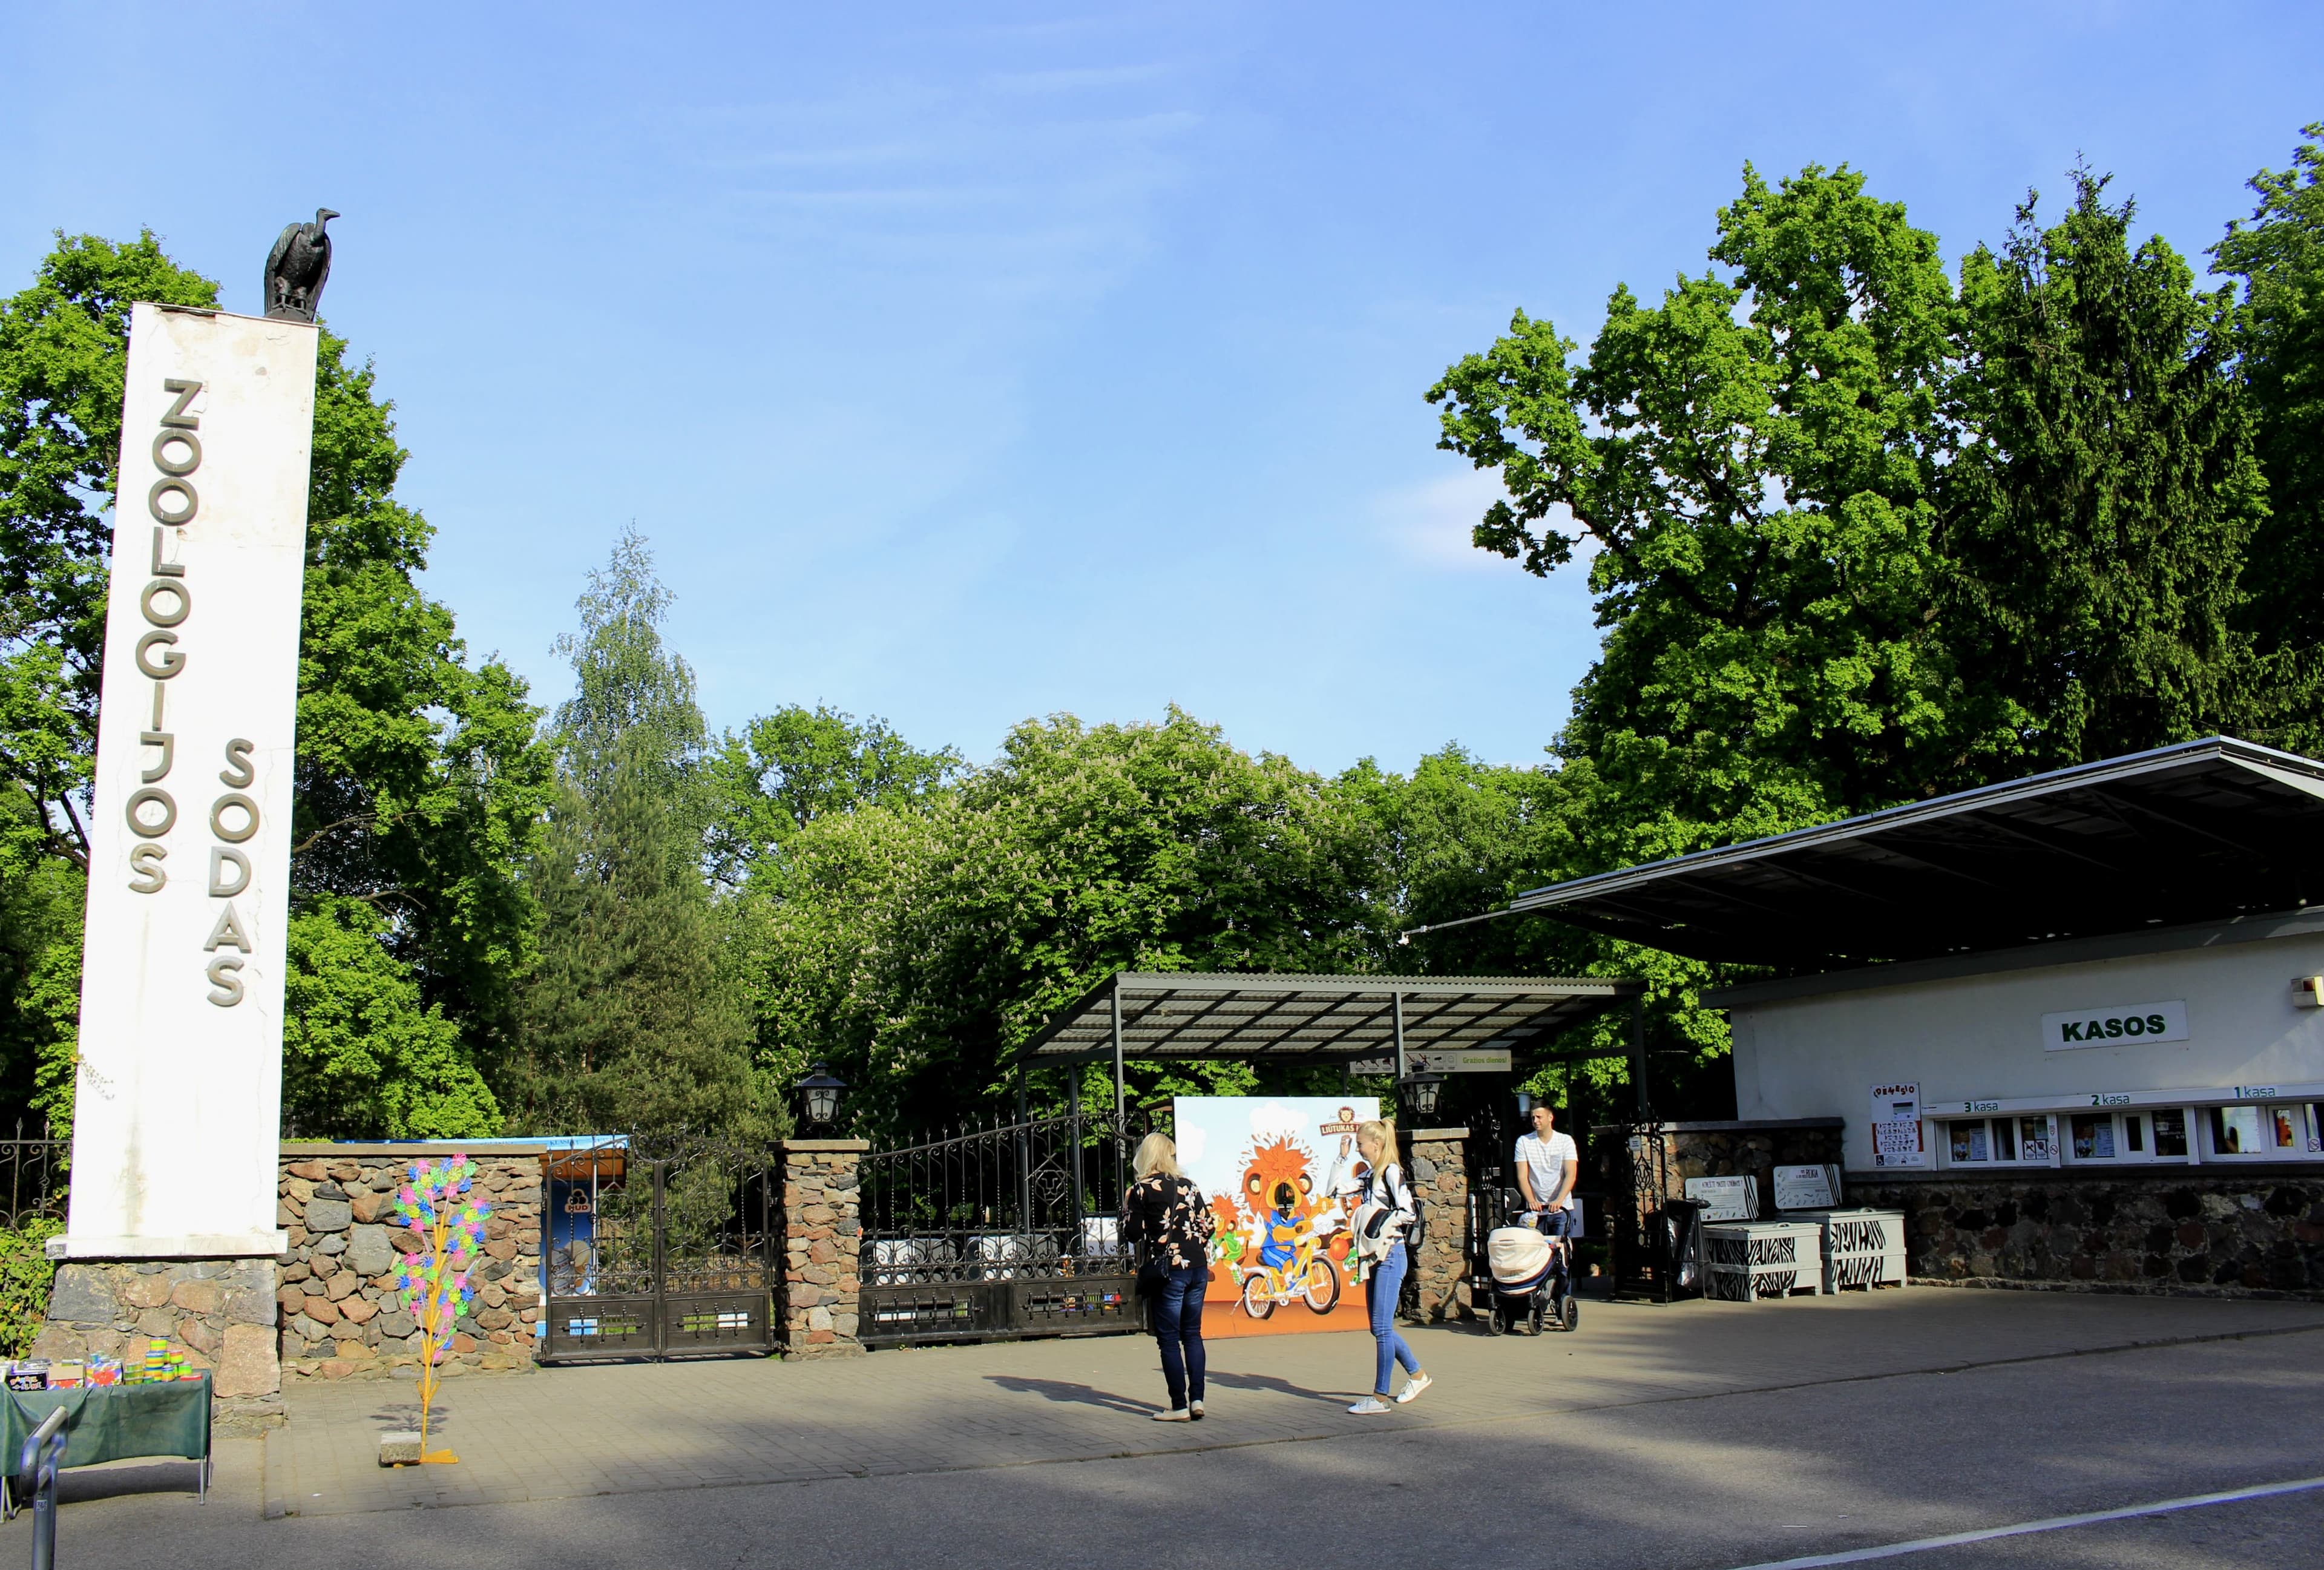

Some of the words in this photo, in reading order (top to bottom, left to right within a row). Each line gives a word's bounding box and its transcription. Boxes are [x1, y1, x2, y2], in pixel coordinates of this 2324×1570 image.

[125, 378, 203, 894] ZOOLOGIJOS
[203, 737, 260, 1007] SODAS
[2061, 1014, 2166, 1042] KASOS
[2091, 1094, 2099, 1105] 2
[2102, 1094, 2130, 1105] kasa
[2234, 1086, 2240, 1098] 1
[2244, 1086, 2276, 1098] kasa
[1964, 1102, 1971, 1112] 3
[1974, 1101, 1998, 1111] kasa
